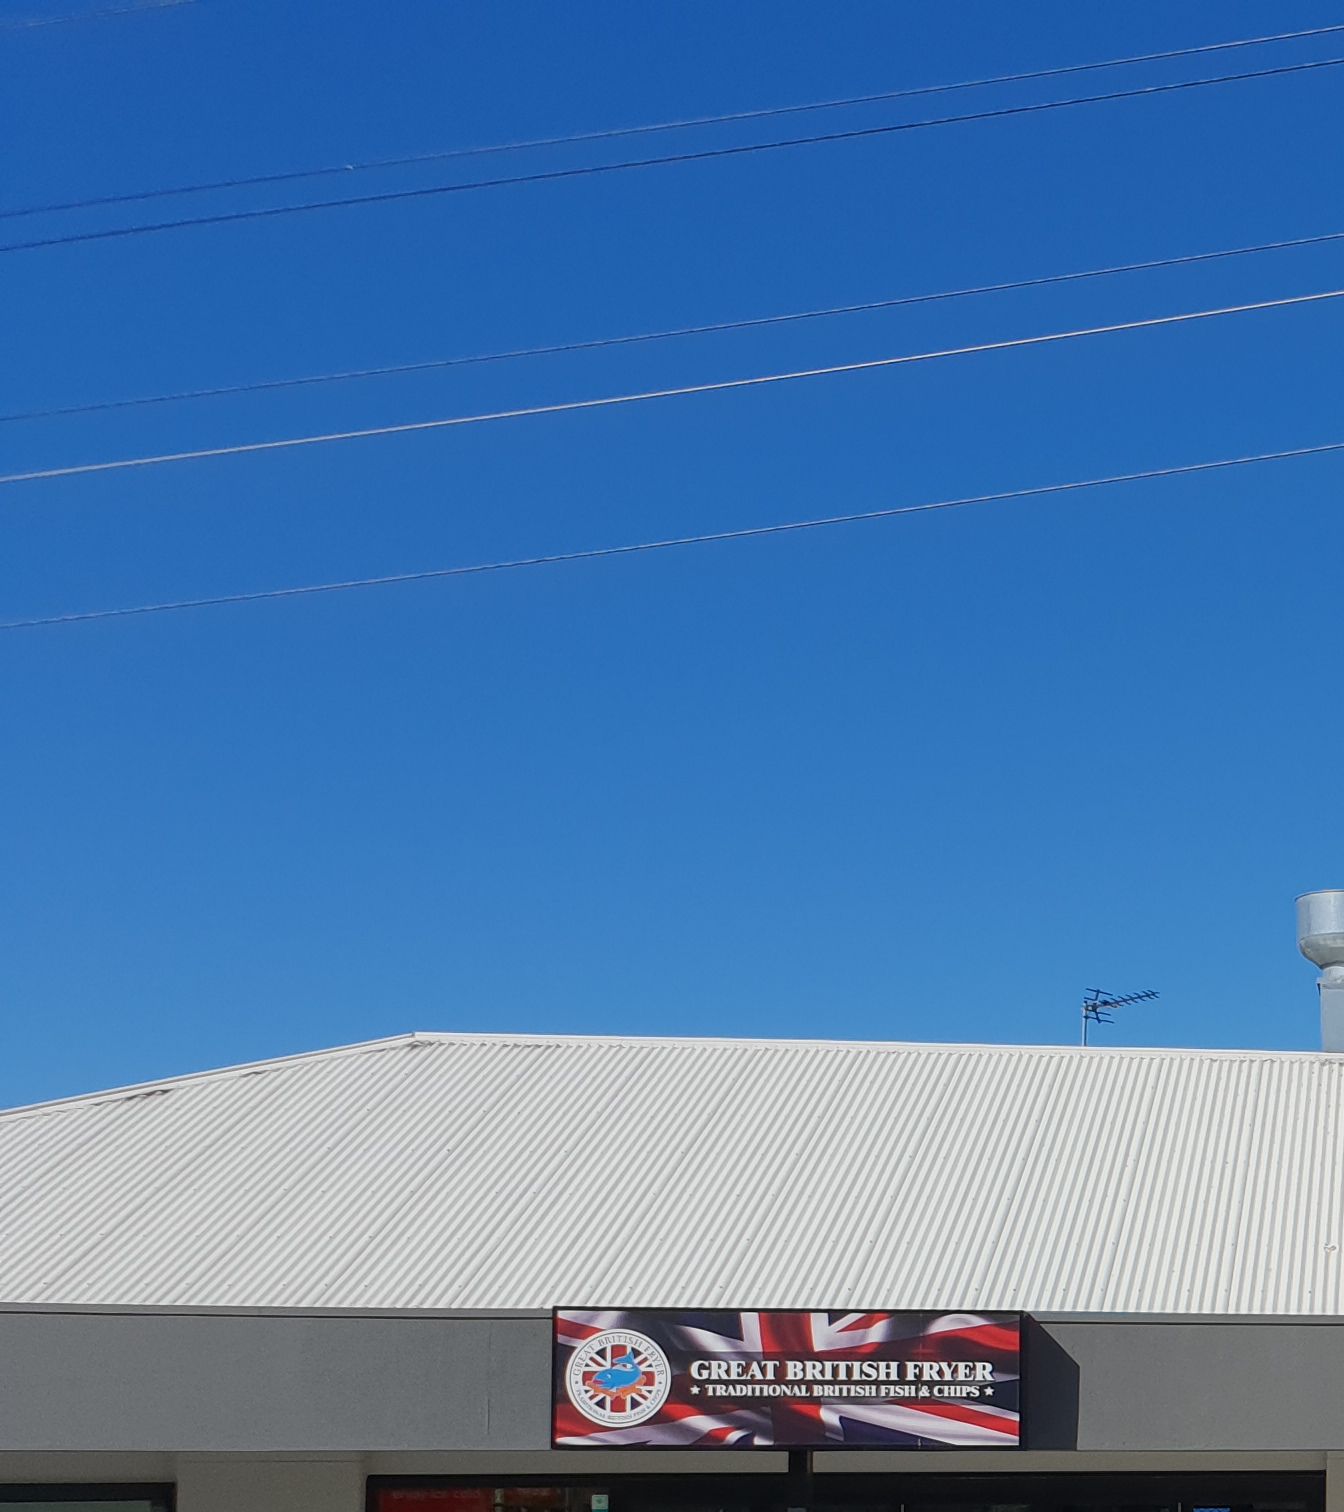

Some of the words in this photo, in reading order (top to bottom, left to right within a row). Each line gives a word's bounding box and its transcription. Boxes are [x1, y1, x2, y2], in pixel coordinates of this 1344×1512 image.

[572, 1344, 597, 1377] GREAT
[597, 1335, 642, 1349] BRITISH
[644, 1344, 665, 1377] FRYER
[690, 1360, 780, 1380] GREAT
[786, 1361, 901, 1381] BRITISH
[905, 1362, 994, 1382] FRYER
[705, 1385, 811, 1397] TRADITIONAL
[812, 1385, 878, 1397] BRITISH
[879, 1385, 917, 1397] FISH
[919, 1385, 931, 1397] &
[931, 1385, 980, 1398] CHIPS
